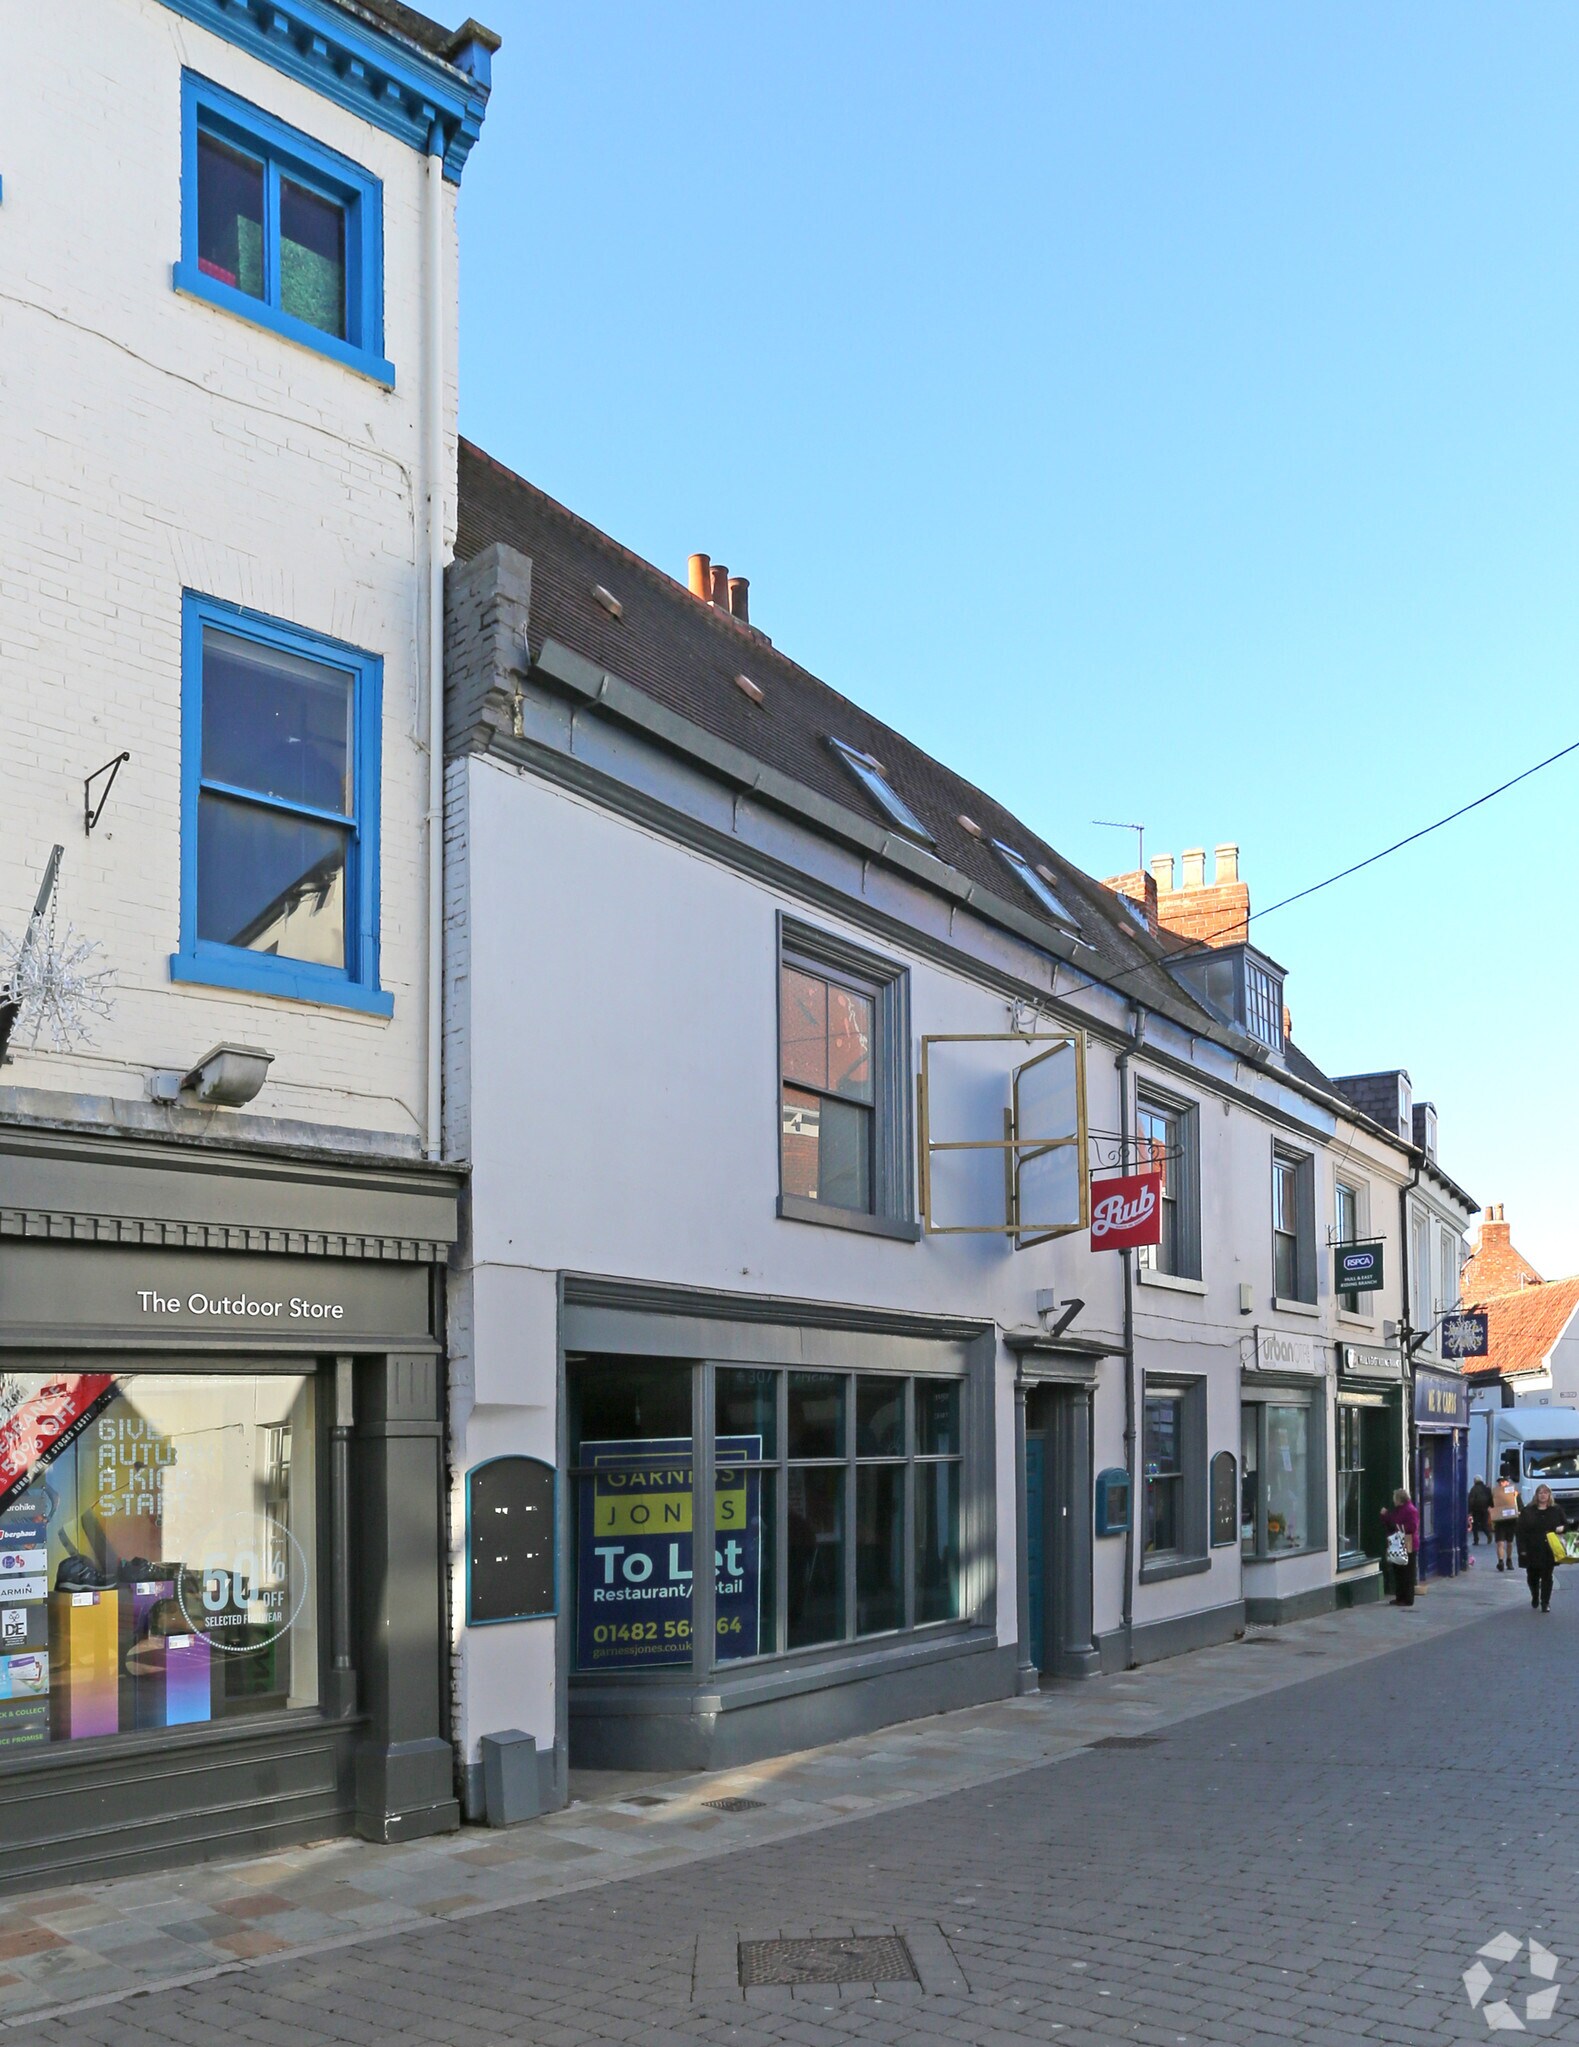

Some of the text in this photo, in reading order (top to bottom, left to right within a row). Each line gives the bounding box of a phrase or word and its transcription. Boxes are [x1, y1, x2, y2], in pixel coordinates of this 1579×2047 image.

[1092, 1184, 1155, 1236] Rub
[1347, 1257, 1371, 1267] RSPCA
[137, 1290, 344, 1319] The Outdoor Store
[1, 1396, 76, 1476] 50% OFF
[98, 1418, 163, 1441] GIVE
[32, 1453, 52, 1474] WHILE
[51, 1430, 75, 1455] STOCKS
[98, 1466, 117, 1491] A
[607, 1471, 735, 1487] GARNS
[607, 1500, 735, 1526] JONS
[4, 1530, 37, 1539] berghaus
[594, 1539, 745, 1584] To Lt
[262, 1590, 285, 1607] OFF
[593, 1579, 744, 1602] Restaurant/tail
[204, 1611, 283, 1628] SELECTED FWEAR
[593, 1616, 742, 1643] 01482 5664
[592, 1640, 693, 1660] garnessjones.co.uk
[15, 1706, 46, 1717] COLLECT
[12, 1733, 44, 1744] PROMISE
